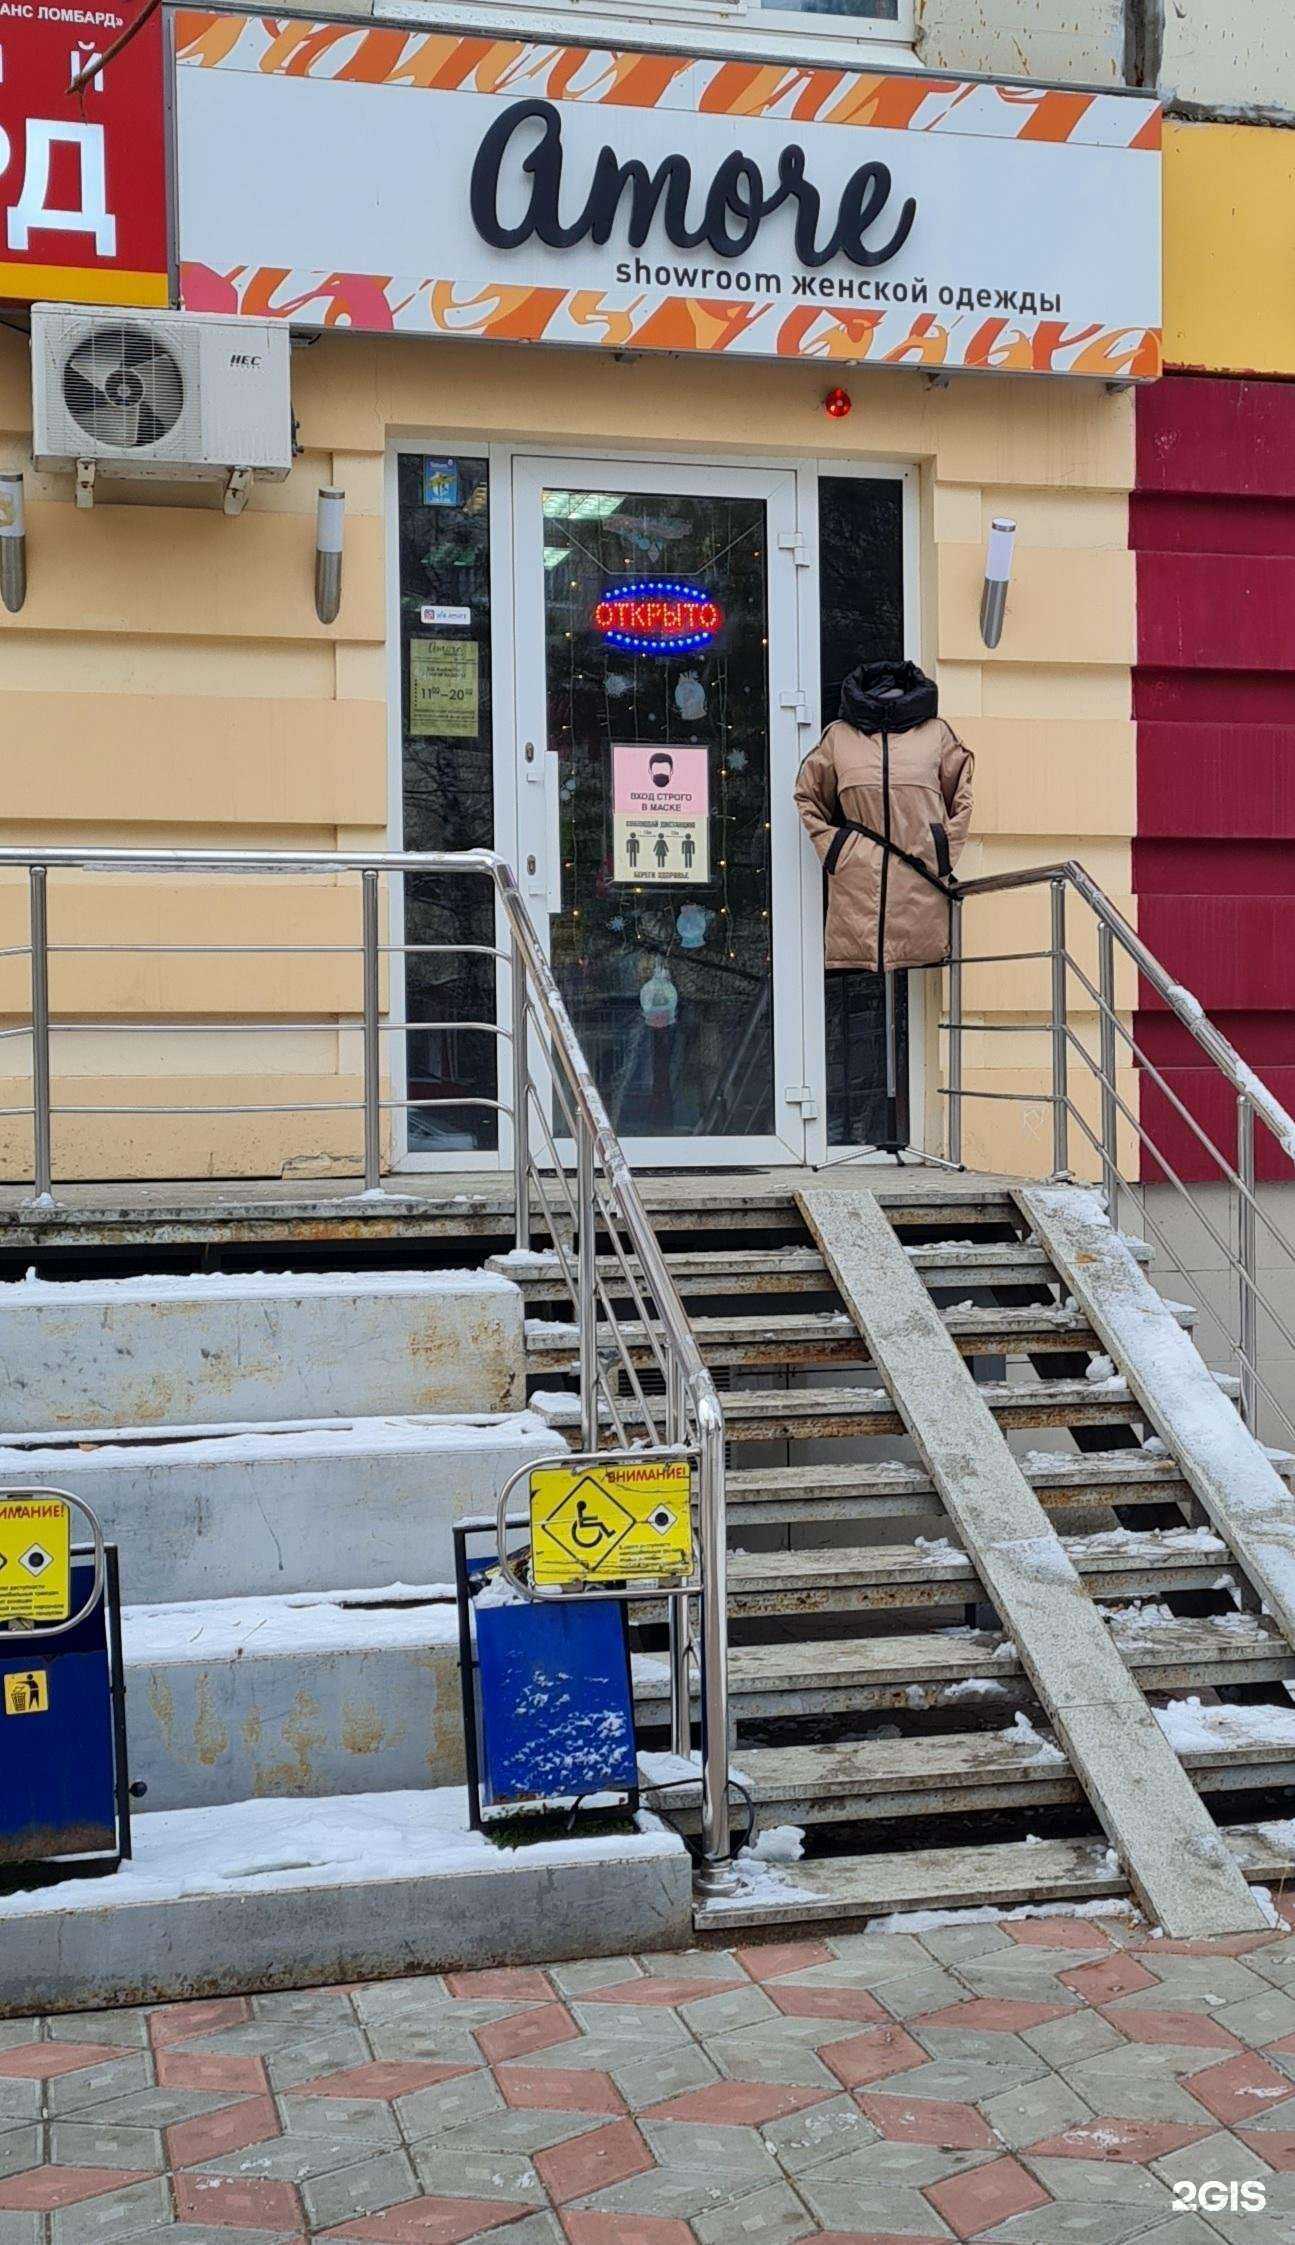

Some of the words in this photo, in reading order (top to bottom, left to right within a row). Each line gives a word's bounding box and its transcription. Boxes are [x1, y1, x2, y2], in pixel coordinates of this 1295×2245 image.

[37, 6, 124, 28] ЛОМБАРД»
[0, 117, 117, 257] Д
[616, 257, 782, 294] showroom
[792, 274, 929, 304] женской
[938, 283, 1061, 315] одежды
[595, 602, 717, 627] ОТКРЫТО
[630, 792, 655, 801] ВХОД
[656, 793, 693, 802] СТРОГО
[641, 803, 648, 811] В
[650, 803, 682, 812] МАСКЕ
[606, 1466, 686, 1483] ВНИМАНИЕ!
